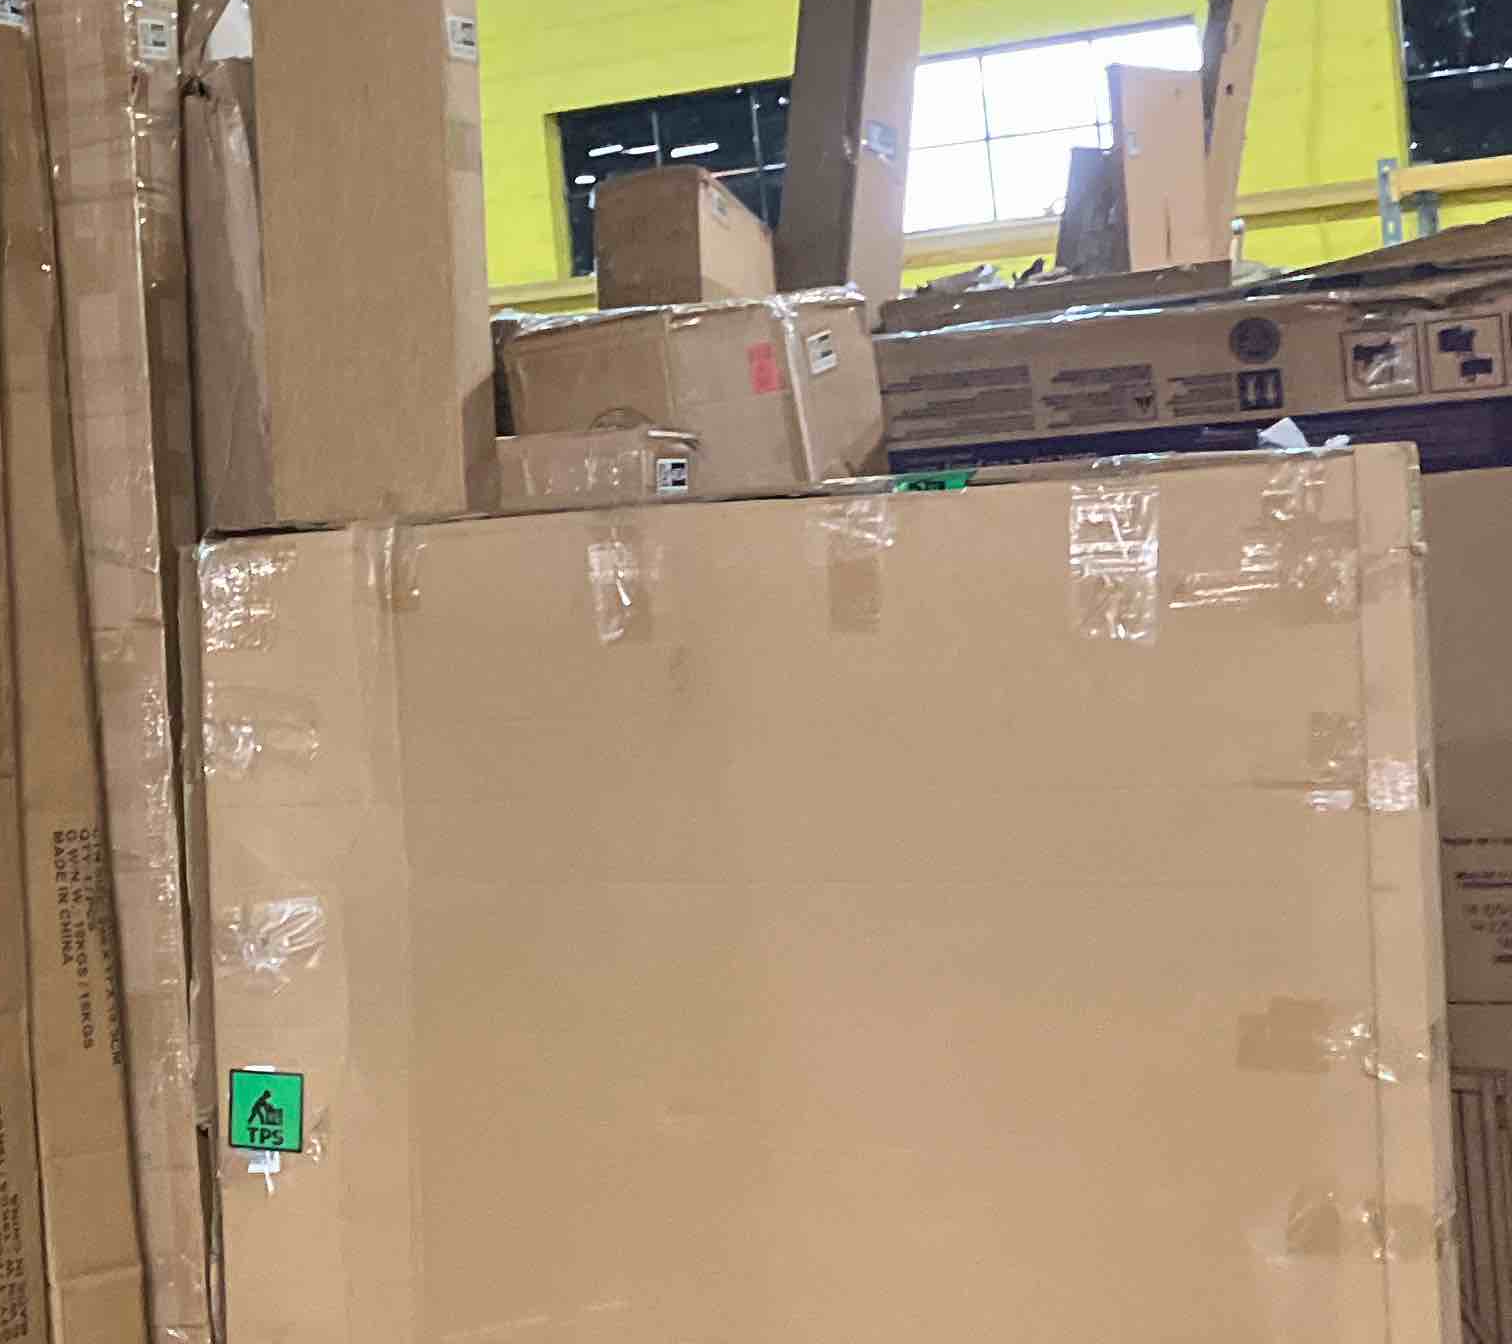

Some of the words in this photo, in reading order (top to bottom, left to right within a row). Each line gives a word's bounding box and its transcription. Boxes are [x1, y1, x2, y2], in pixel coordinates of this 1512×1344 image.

[53, 831, 67, 881] MADE
[57, 886, 70, 905] IN
[59, 908, 74, 967] CHINA
[247, 1126, 285, 1146] TPS
